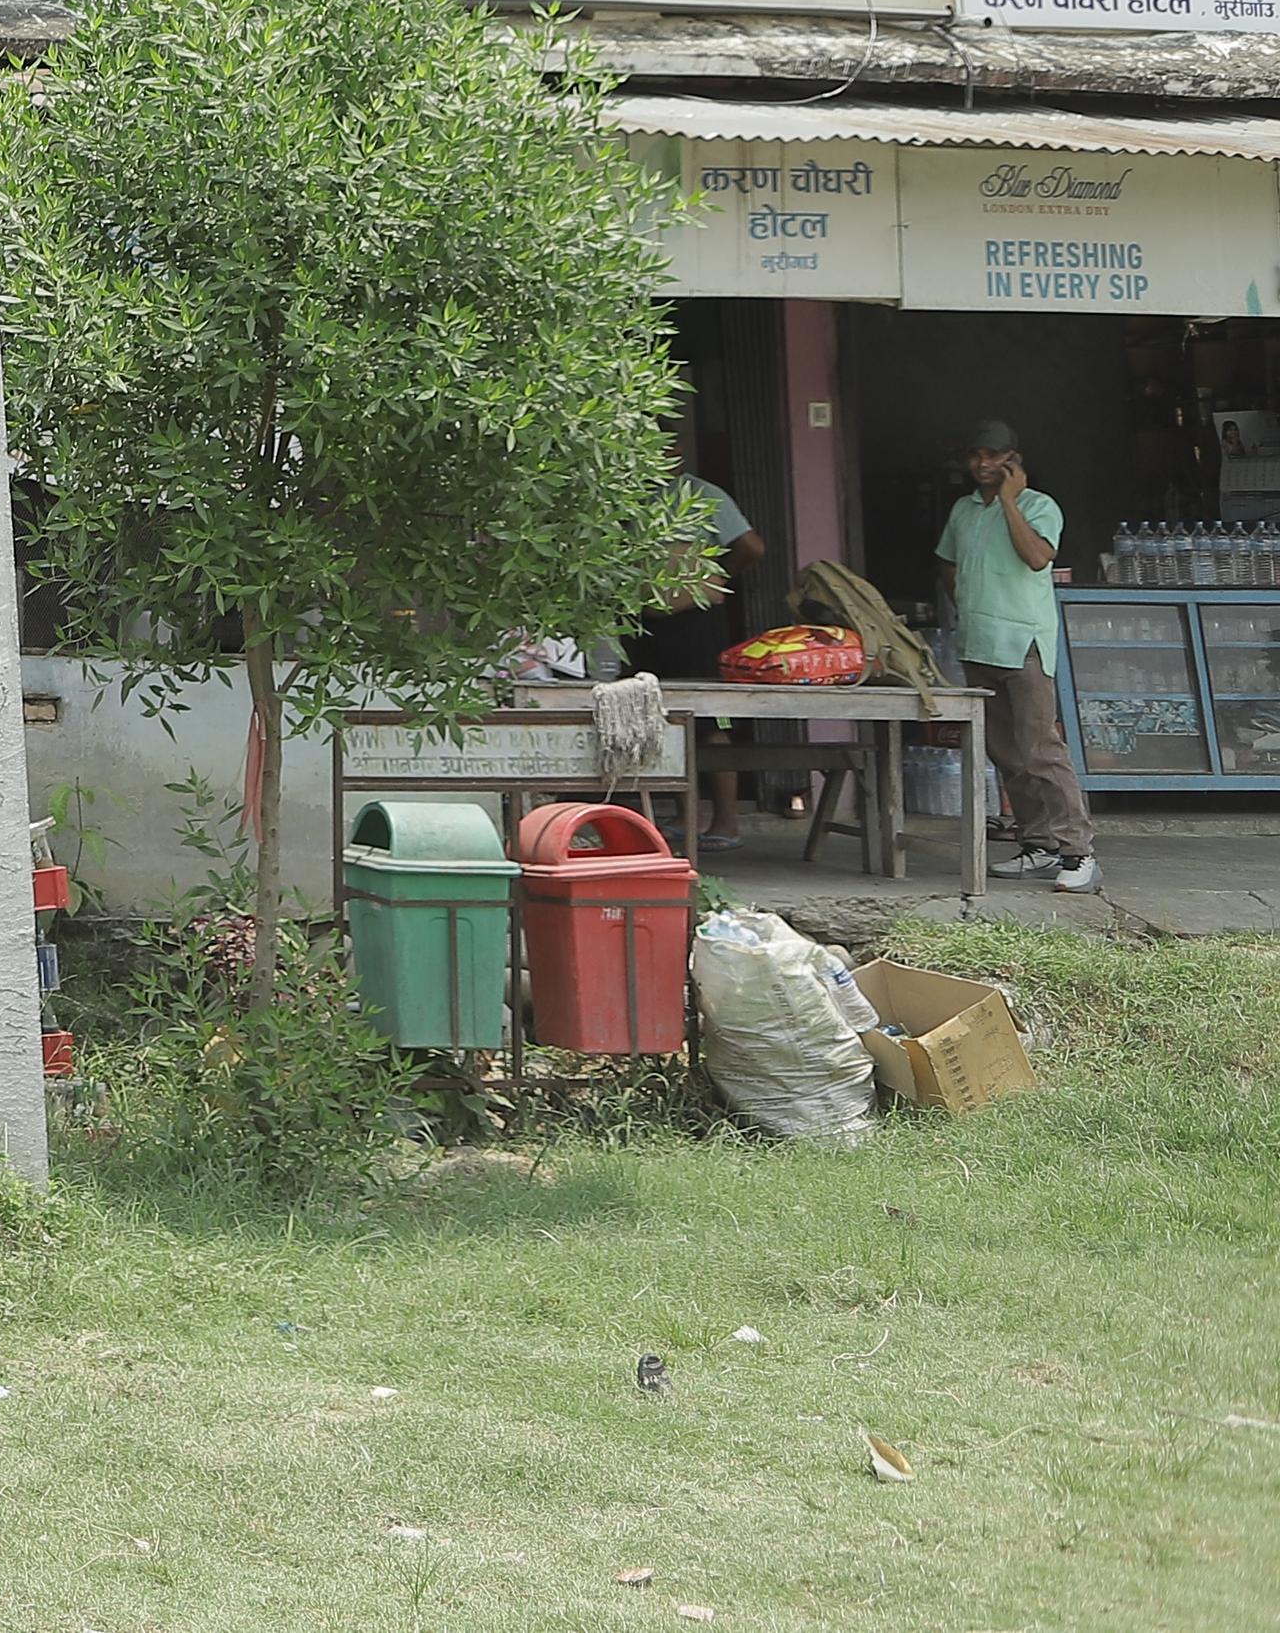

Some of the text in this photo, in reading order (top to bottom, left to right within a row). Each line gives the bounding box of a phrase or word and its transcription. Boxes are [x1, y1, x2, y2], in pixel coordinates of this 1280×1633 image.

[702, 159, 874, 195] करण चौधरी
[979, 164, 1133, 200] Blue Diamond
[748, 204, 829, 240] होटल
[983, 203, 1111, 216] LONDON EXTRA DRY
[985, 240, 1143, 270] REFRESHING
[987, 272, 1149, 301] IN EVERY SIP
